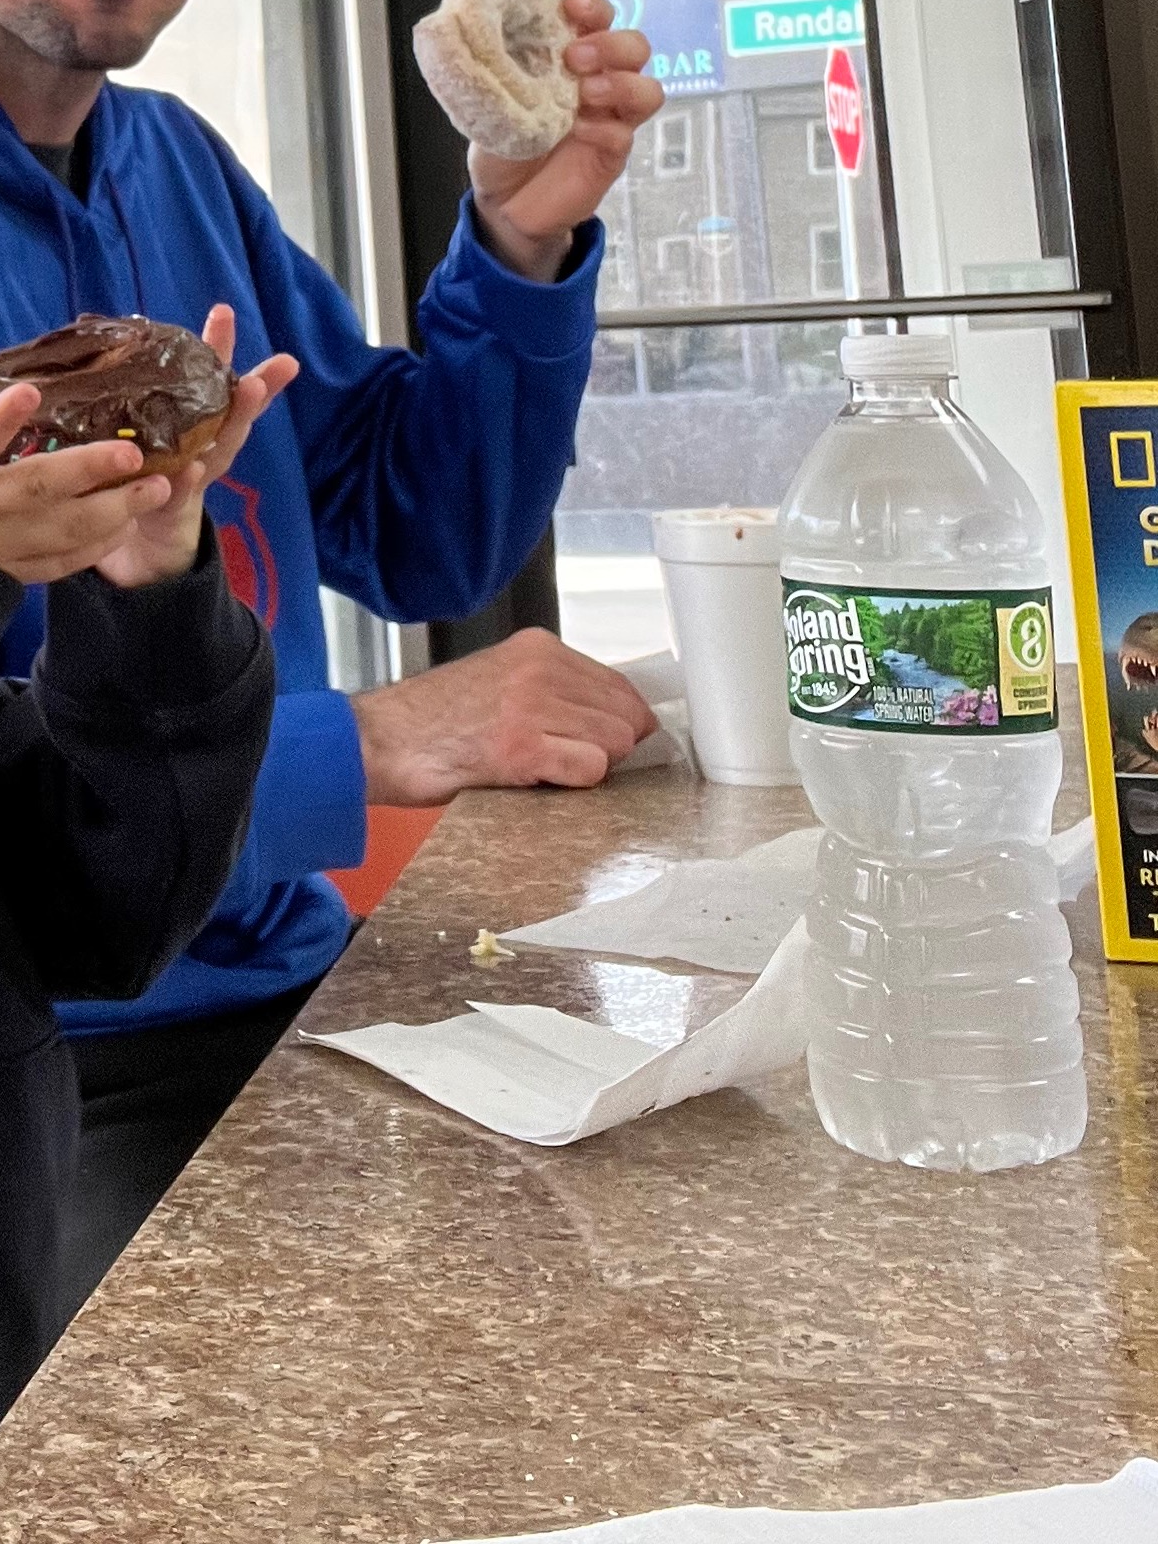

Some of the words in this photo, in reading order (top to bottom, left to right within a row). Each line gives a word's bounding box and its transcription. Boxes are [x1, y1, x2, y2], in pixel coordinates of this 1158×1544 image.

[653, 49, 714, 79] BAR
[829, 81, 859, 136] STOP
[811, 681, 838, 696] 1845
[873, 685, 897, 704] 100%
[896, 687, 935, 705] NATURAL
[874, 702, 903, 720] SPRING
[904, 705, 934, 723] WATER
